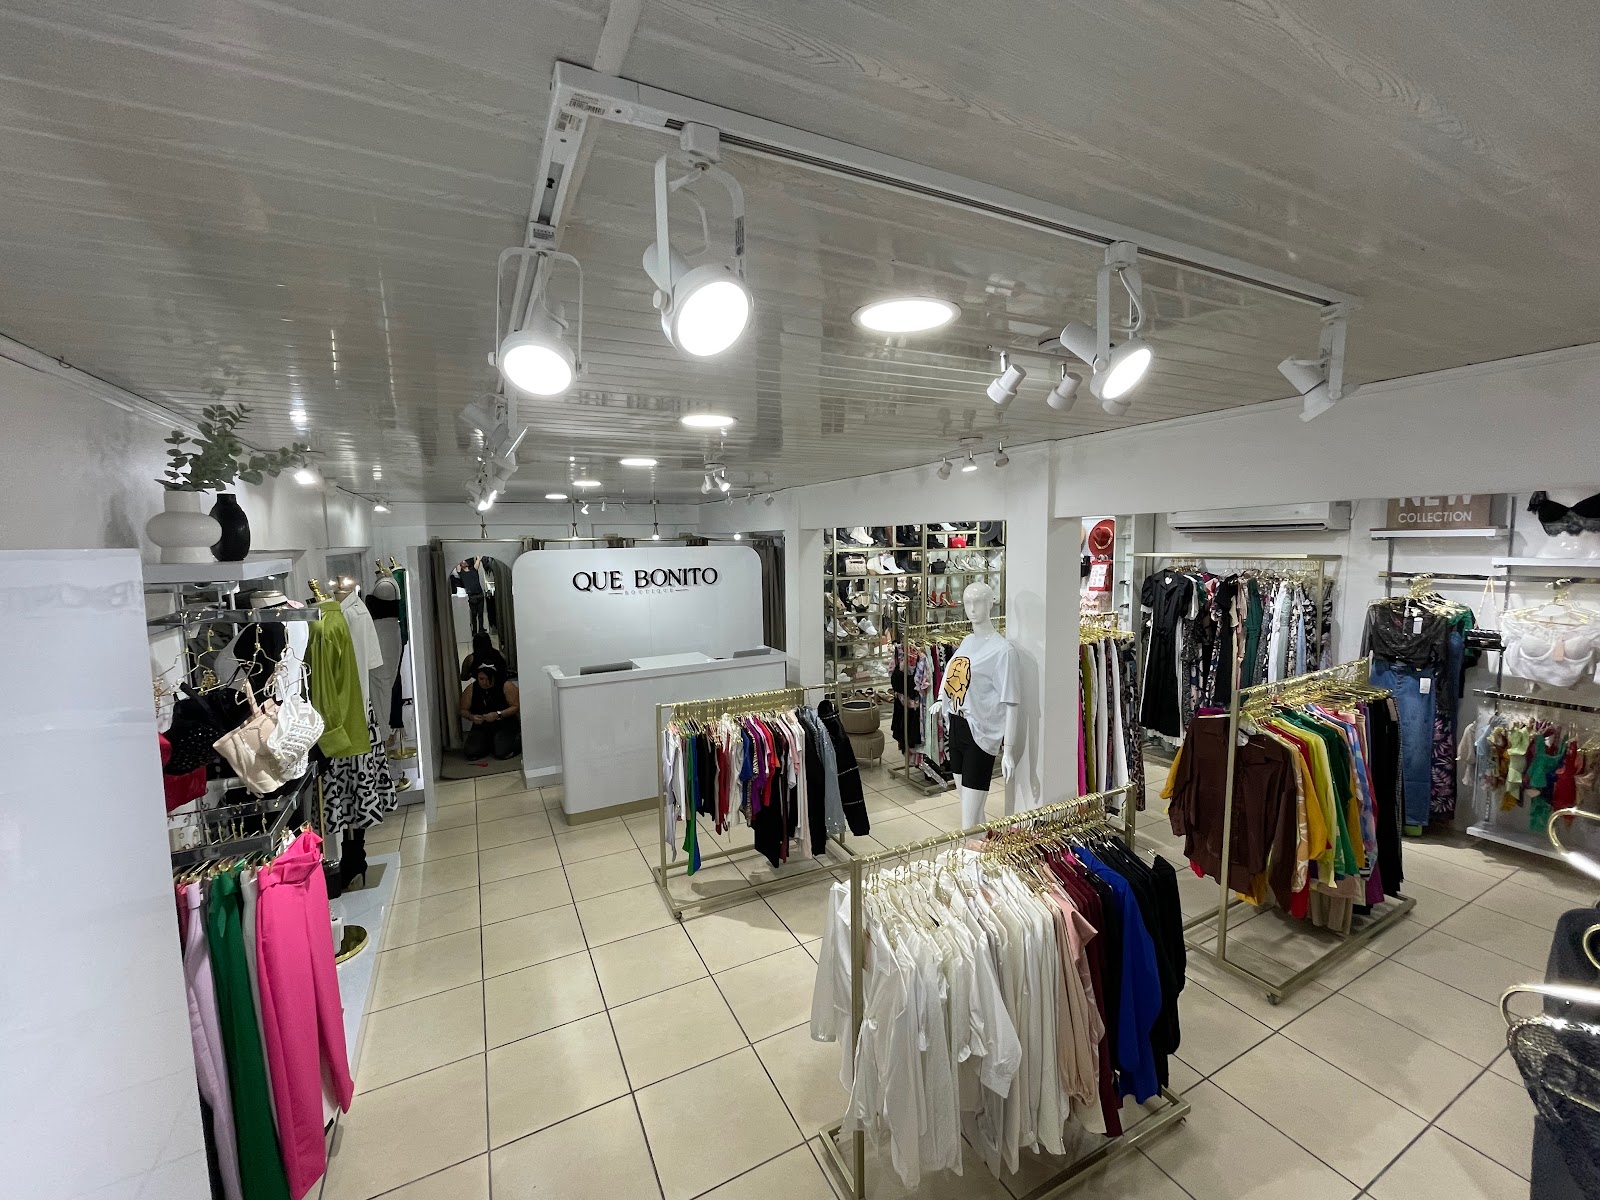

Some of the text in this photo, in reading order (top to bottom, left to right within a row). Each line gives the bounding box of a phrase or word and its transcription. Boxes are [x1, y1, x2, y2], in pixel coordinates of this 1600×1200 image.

[1398, 511, 1472, 523] COLLECTION
[573, 567, 718, 592] QUE BONITO
